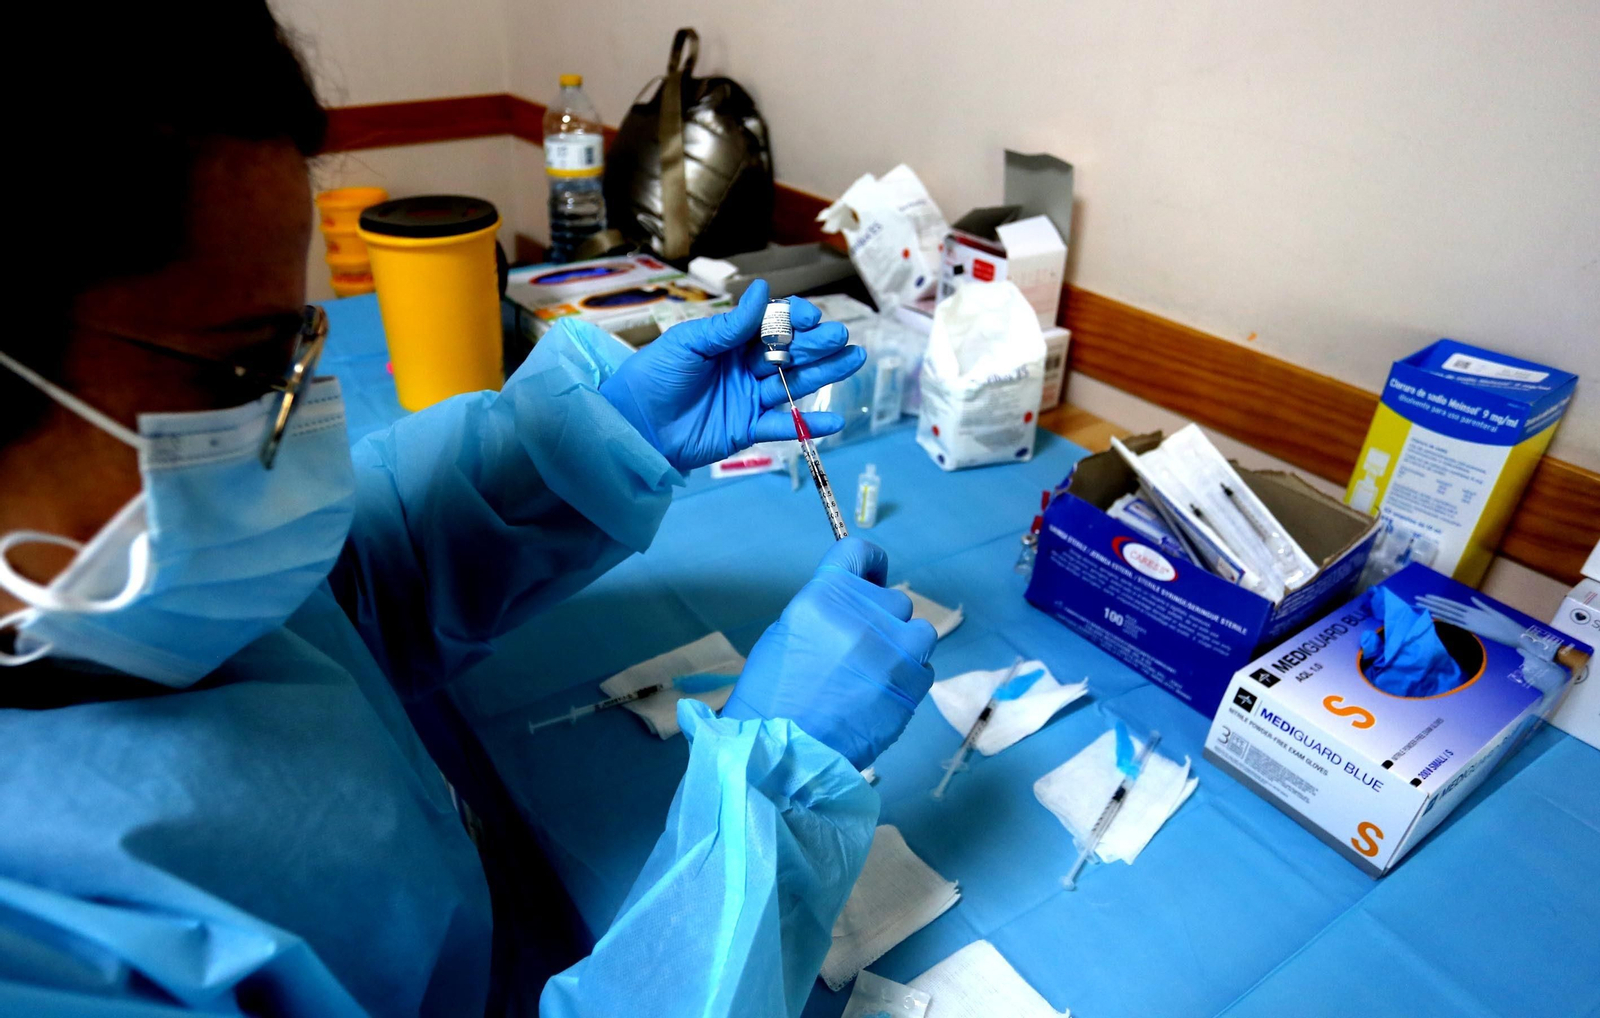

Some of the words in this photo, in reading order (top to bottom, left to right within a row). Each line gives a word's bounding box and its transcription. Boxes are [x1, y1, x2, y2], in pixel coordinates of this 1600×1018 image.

[1416, 388, 1426, 399] de
[1482, 409, 1490, 419] 9
[1490, 413, 1520, 429] mg/ml
[1431, 406, 1447, 417] para
[1460, 416, 1498, 433] parenteral
[1104, 607, 1124, 627] 100
[1220, 617, 1248, 636] STERILE
[1271, 623, 1349, 674] MEDIGUARD
[1295, 670, 1314, 683] AQL
[1310, 662, 1324, 673] 1.0
[1322, 695, 1376, 729] S
[1228, 707, 1249, 724] NITRILE
[1249, 720, 1288, 751] POWDER-FREE
[1288, 746, 1306, 762] EXAM
[1305, 758, 1329, 777] GLOVES
[1260, 708, 1342, 766] MEDIGUARD
[1343, 761, 1384, 793] BLUE
[1428, 755, 1448, 770] SMALL
[1351, 821, 1384, 858] S
